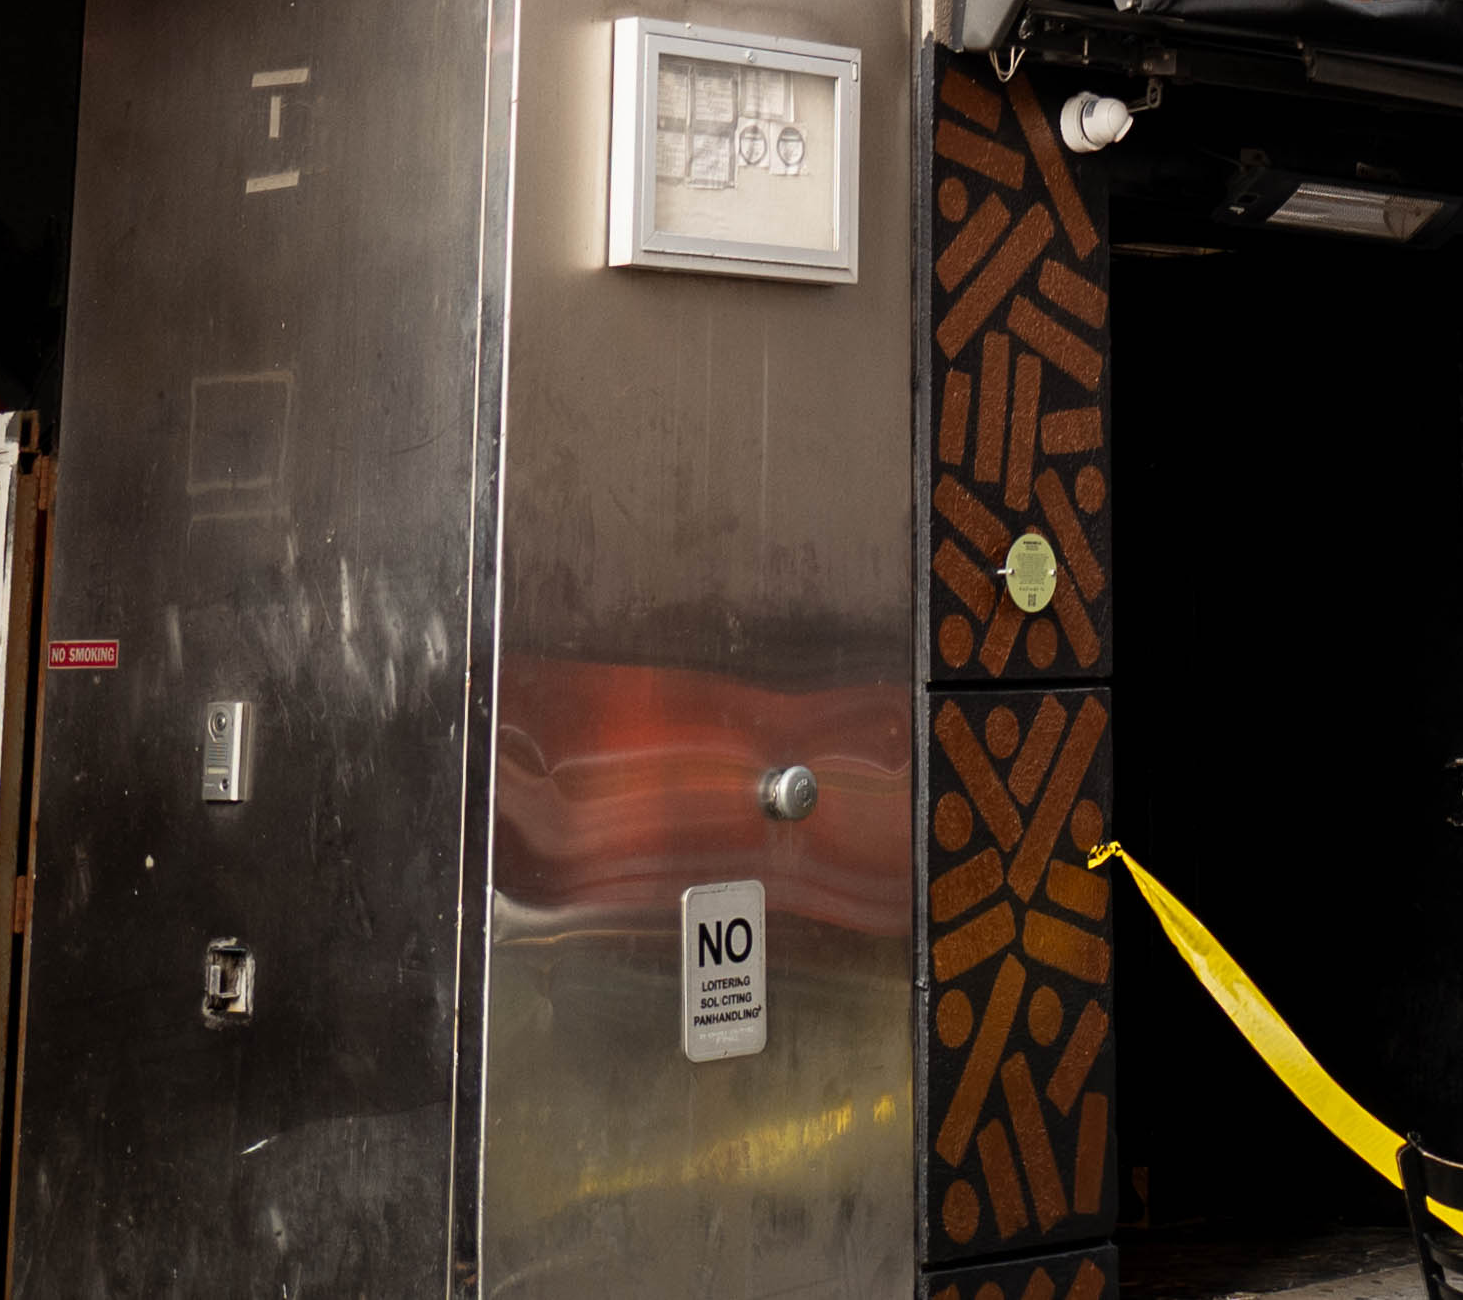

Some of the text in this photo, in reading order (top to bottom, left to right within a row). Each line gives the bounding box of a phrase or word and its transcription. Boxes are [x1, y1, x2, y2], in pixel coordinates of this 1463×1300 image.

[51, 647, 115, 662] NO SMOKING
[699, 917, 753, 968] NO
[702, 975, 751, 992] LOITERING
[701, 992, 752, 1008] SOLCITING
[693, 1008, 761, 1027] PANHANDLING
